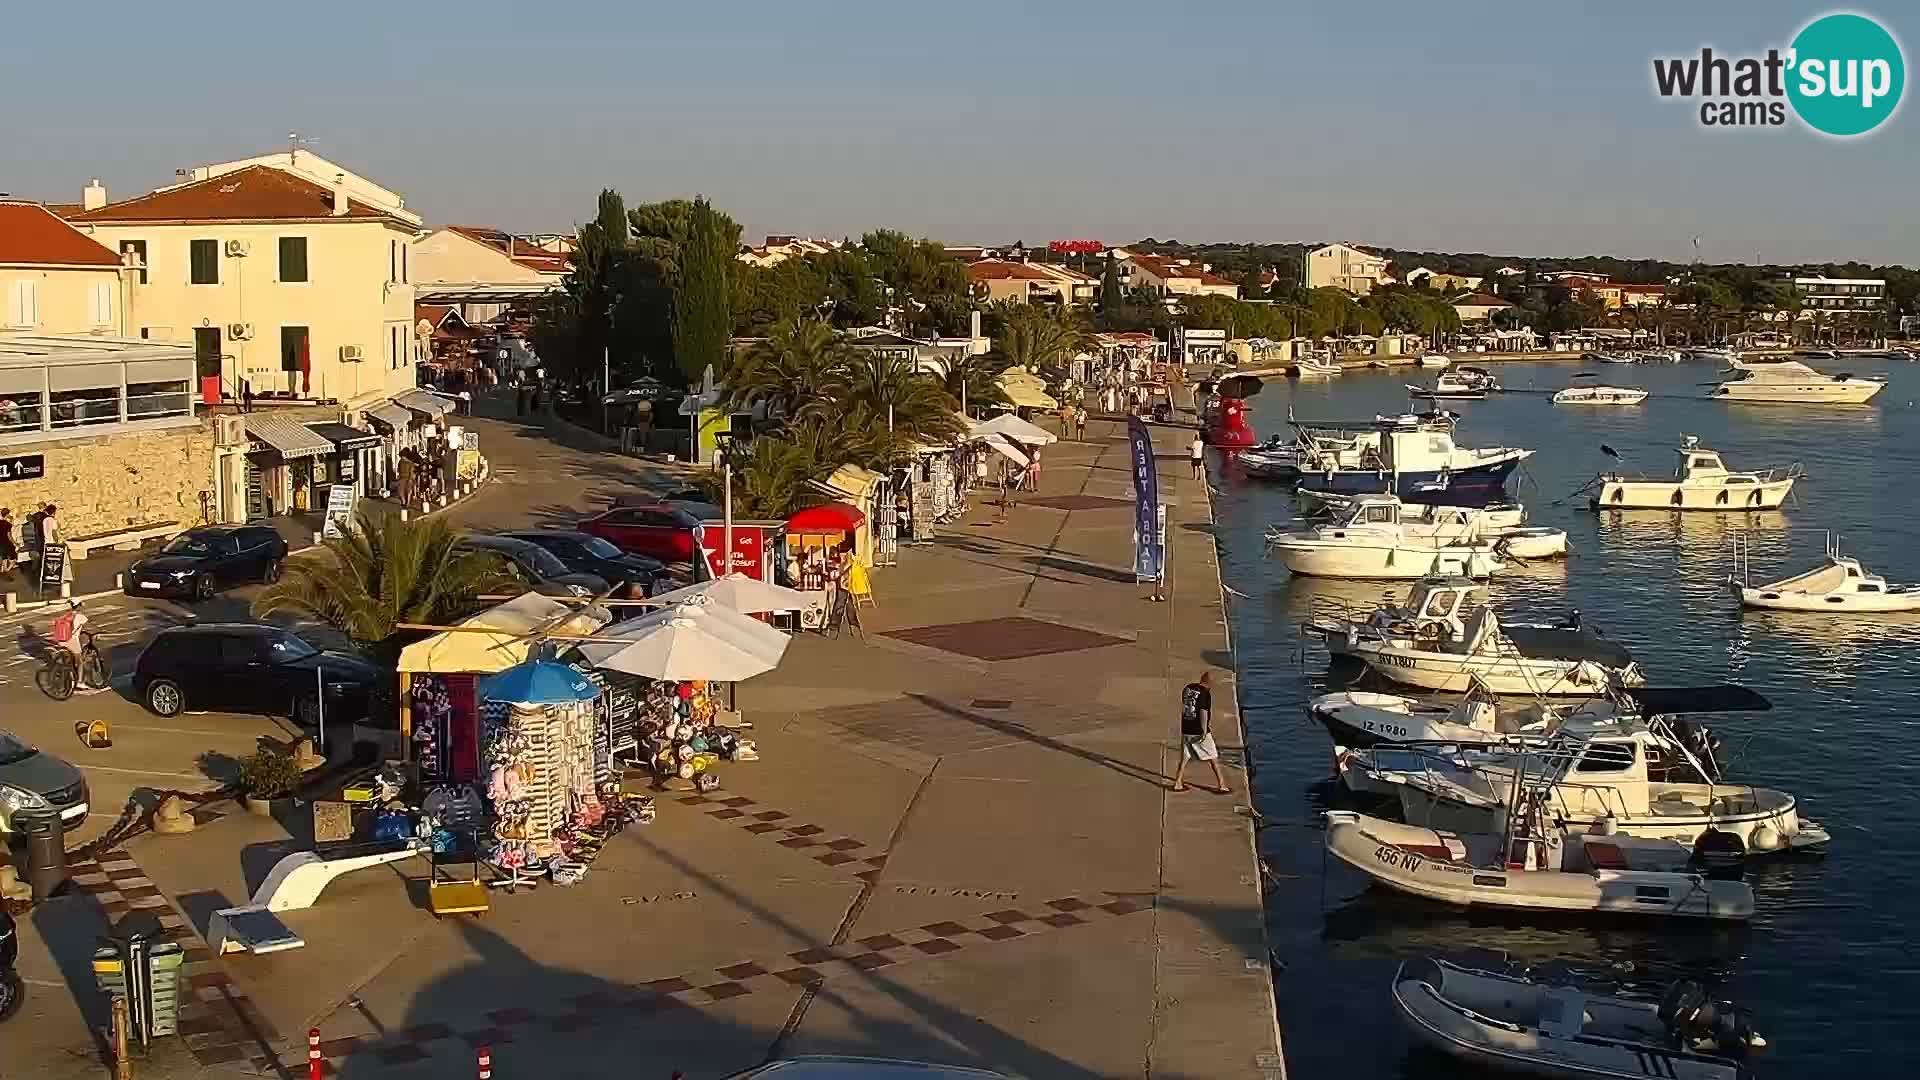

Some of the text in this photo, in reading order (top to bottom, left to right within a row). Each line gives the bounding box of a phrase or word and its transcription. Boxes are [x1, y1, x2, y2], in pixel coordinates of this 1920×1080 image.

[1380, 724, 1407, 737] 1980
[1374, 846, 1399, 866] 456
[1400, 853, 1422, 872] NV
